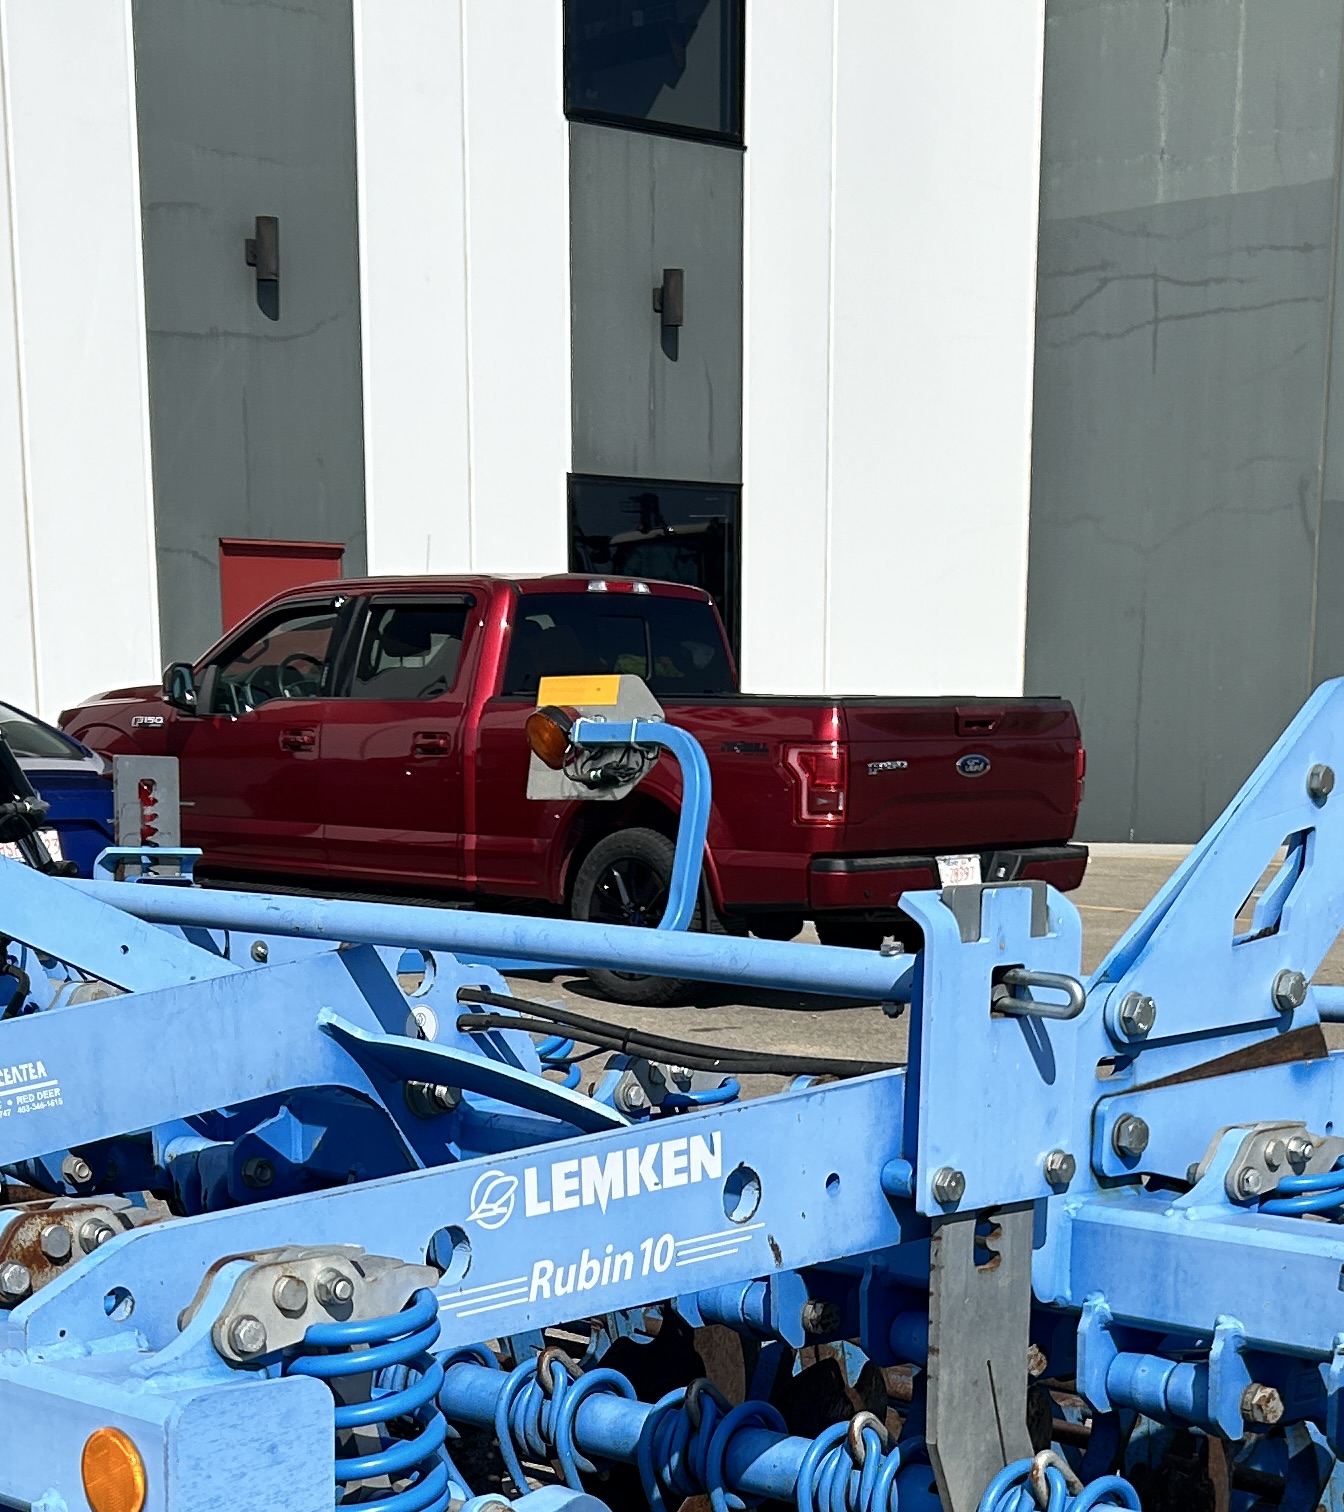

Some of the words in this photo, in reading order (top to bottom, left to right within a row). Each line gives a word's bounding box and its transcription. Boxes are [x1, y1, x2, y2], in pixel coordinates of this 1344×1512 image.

[16, 1094, 35, 1106] RED
[37, 1087, 61, 1101] DEER
[524, 1131, 723, 1217] LEMKEN
[528, 1246, 634, 1302] Rubin
[640, 1233, 676, 1275] 10
